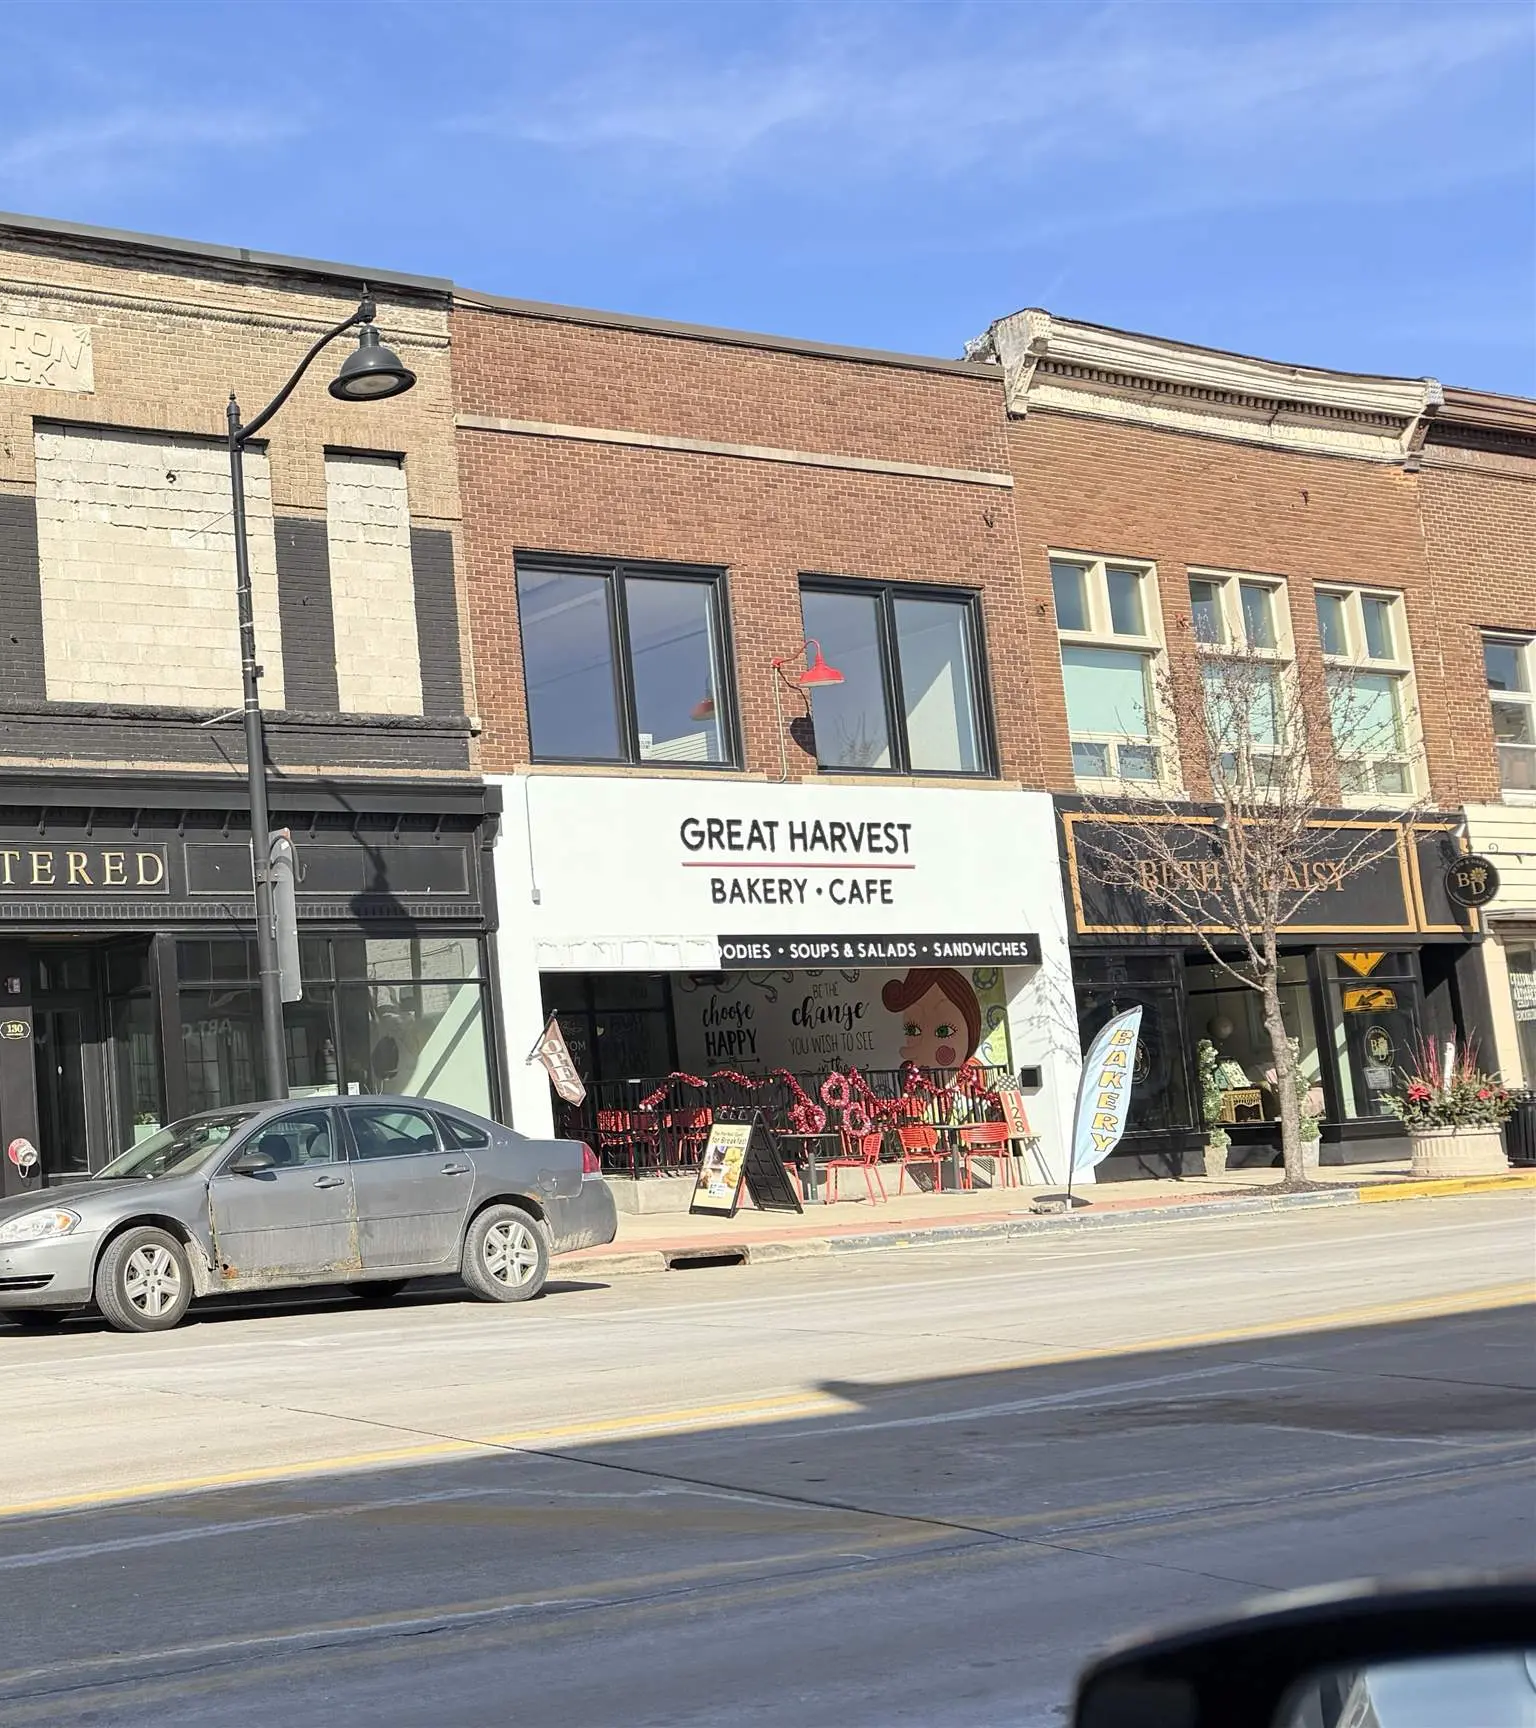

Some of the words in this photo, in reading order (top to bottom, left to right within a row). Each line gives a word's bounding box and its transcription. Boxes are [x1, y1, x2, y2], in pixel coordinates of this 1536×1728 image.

[680, 817, 779, 851] GREAT
[788, 819, 912, 854] HARVEST
[710, 877, 808, 904] BAKERY
[828, 878, 894, 905] CAFE
[789, 943, 840, 959] SOUPS
[843, 942, 854, 958] &
[858, 942, 917, 958] SALADS
[933, 941, 1029, 957] SANDWICHES
[7, 1023, 24, 1033] 130
[791, 996, 869, 1031] change
[704, 1028, 757, 1057] HAPPY
[789, 1037, 809, 1056] YOU
[810, 1034, 838, 1054] WISH
[841, 1033, 854, 1052] TO
[856, 1031, 875, 1050] SEE
[1091, 1029, 1135, 1152] BAKERY
[1008, 1092, 1025, 1134] 128
